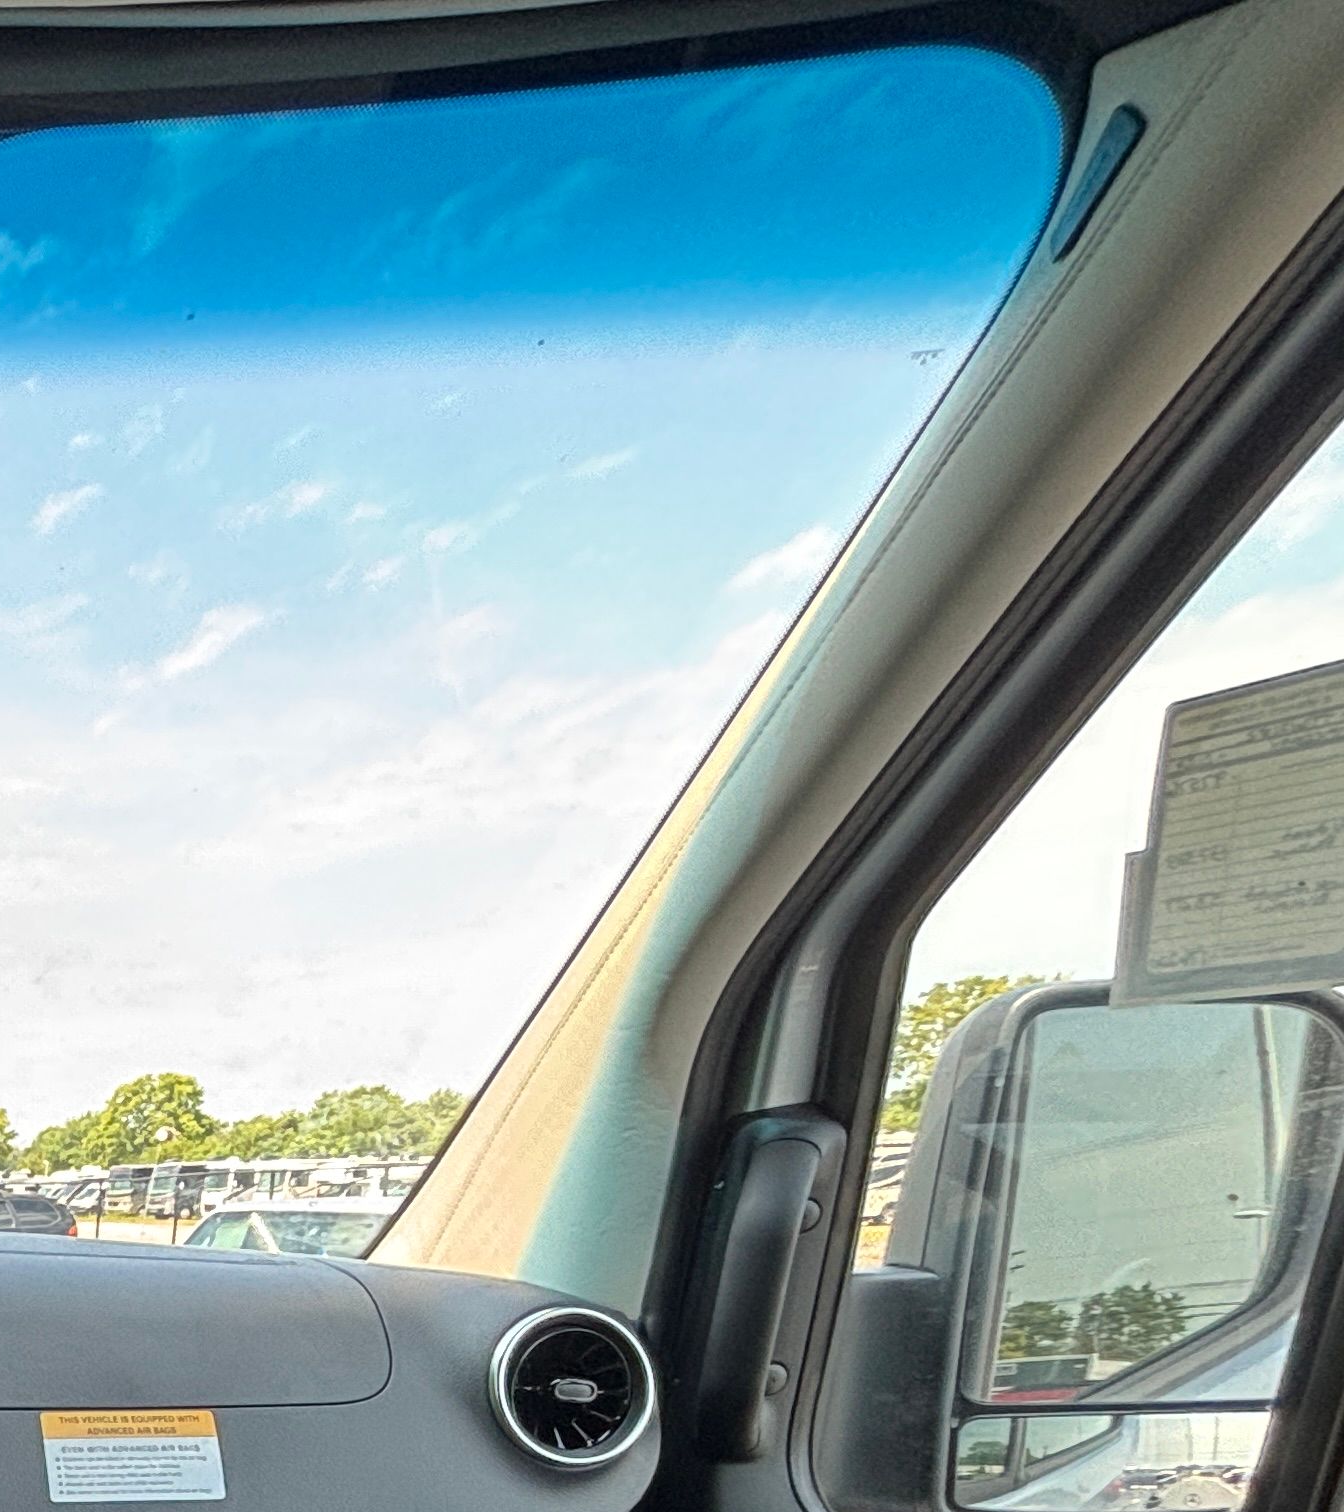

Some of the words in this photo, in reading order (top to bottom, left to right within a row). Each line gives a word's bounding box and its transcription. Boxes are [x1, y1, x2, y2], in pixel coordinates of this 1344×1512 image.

[58, 1415, 79, 1424] THIS
[80, 1415, 117, 1423] VEHICLE
[120, 1415, 130, 1424] IS
[131, 1414, 175, 1423] EQUIPPED
[176, 1414, 199, 1422] WITH
[87, 1427, 135, 1435] ADVANCED
[137, 1427, 151, 1435] AIR
